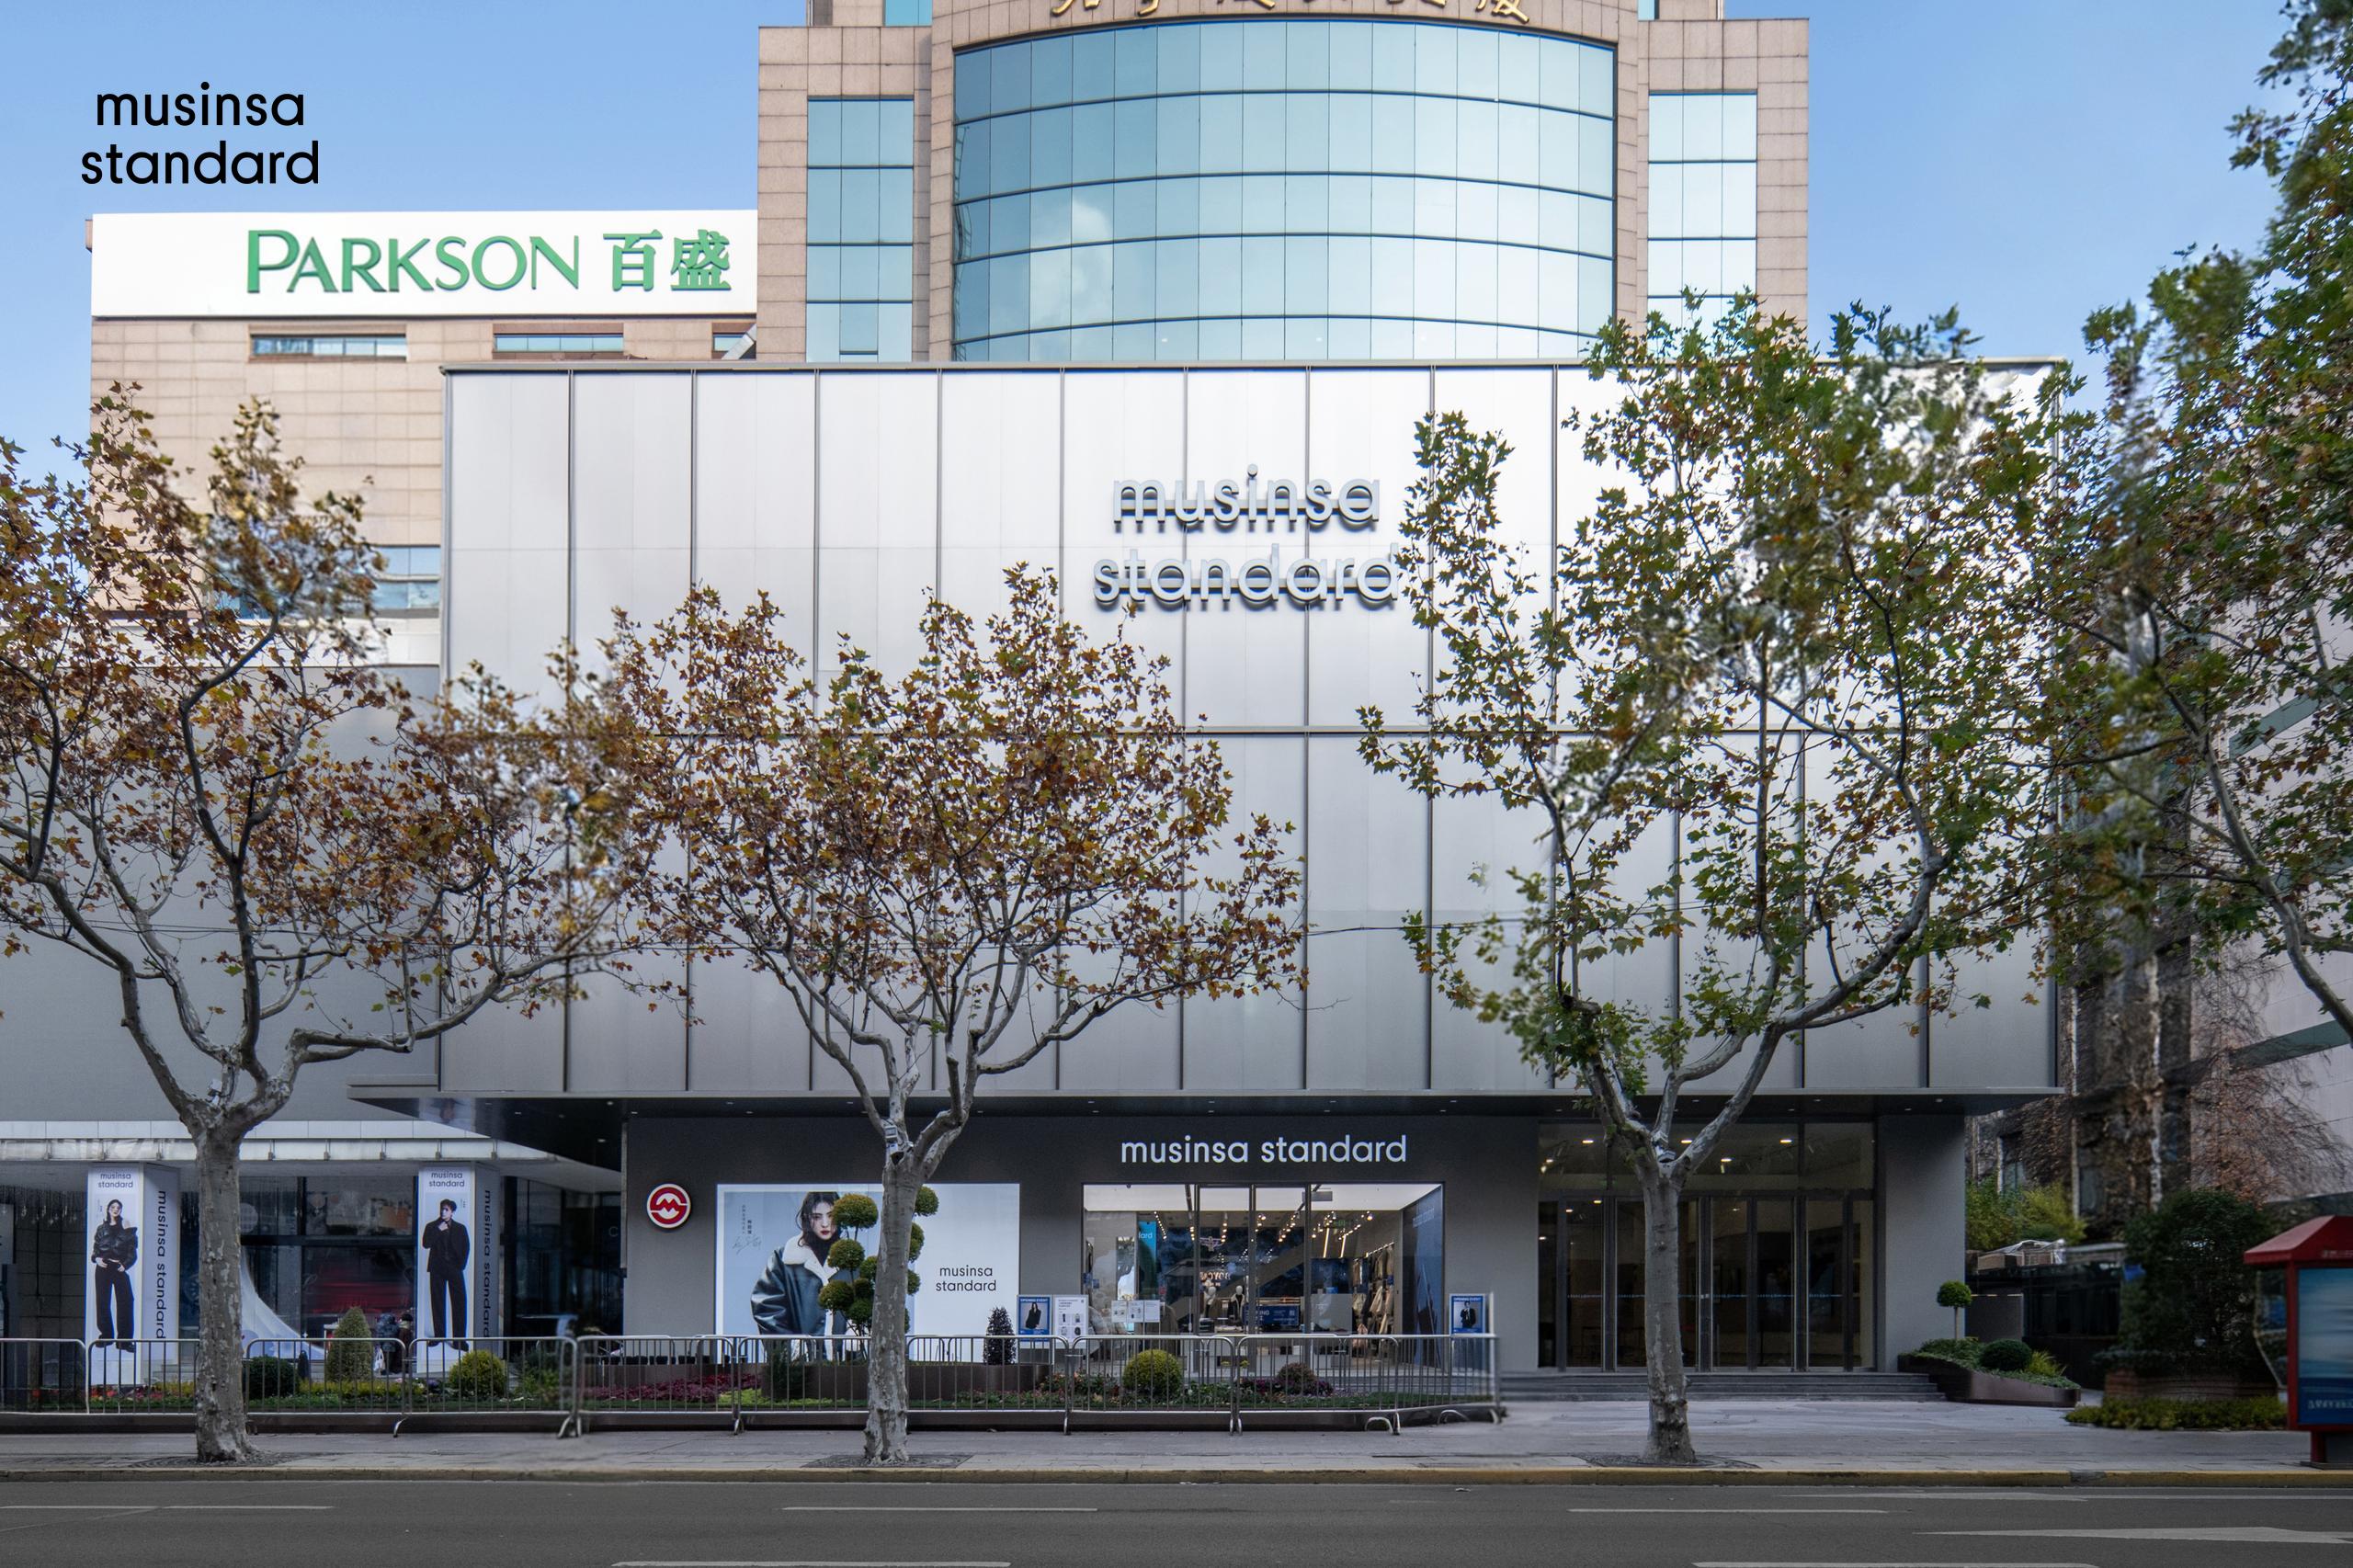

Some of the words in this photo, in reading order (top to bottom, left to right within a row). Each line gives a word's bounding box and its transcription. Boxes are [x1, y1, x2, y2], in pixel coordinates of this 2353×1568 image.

[247, 230, 579, 292] PARKSON
[603, 229, 732, 292] 百盛
[1112, 463, 1381, 523] musinsa
[1092, 542, 1399, 603] standard
[1121, 1134, 1248, 1164] musinsa
[1261, 1134, 1406, 1163] standard
[97, 1180, 133, 1188] standard
[100, 1172, 131, 1180] musinsa
[428, 1179, 465, 1187] standard
[431, 1170, 463, 1179] musinsa
[157, 1190, 169, 1257] musinsa
[483, 1189, 494, 1256] musinsa
[935, 1278, 997, 1292] standard
[939, 1264, 993, 1278] musinsa
[155, 1264, 166, 1339] standard
[483, 1263, 492, 1338] standard
